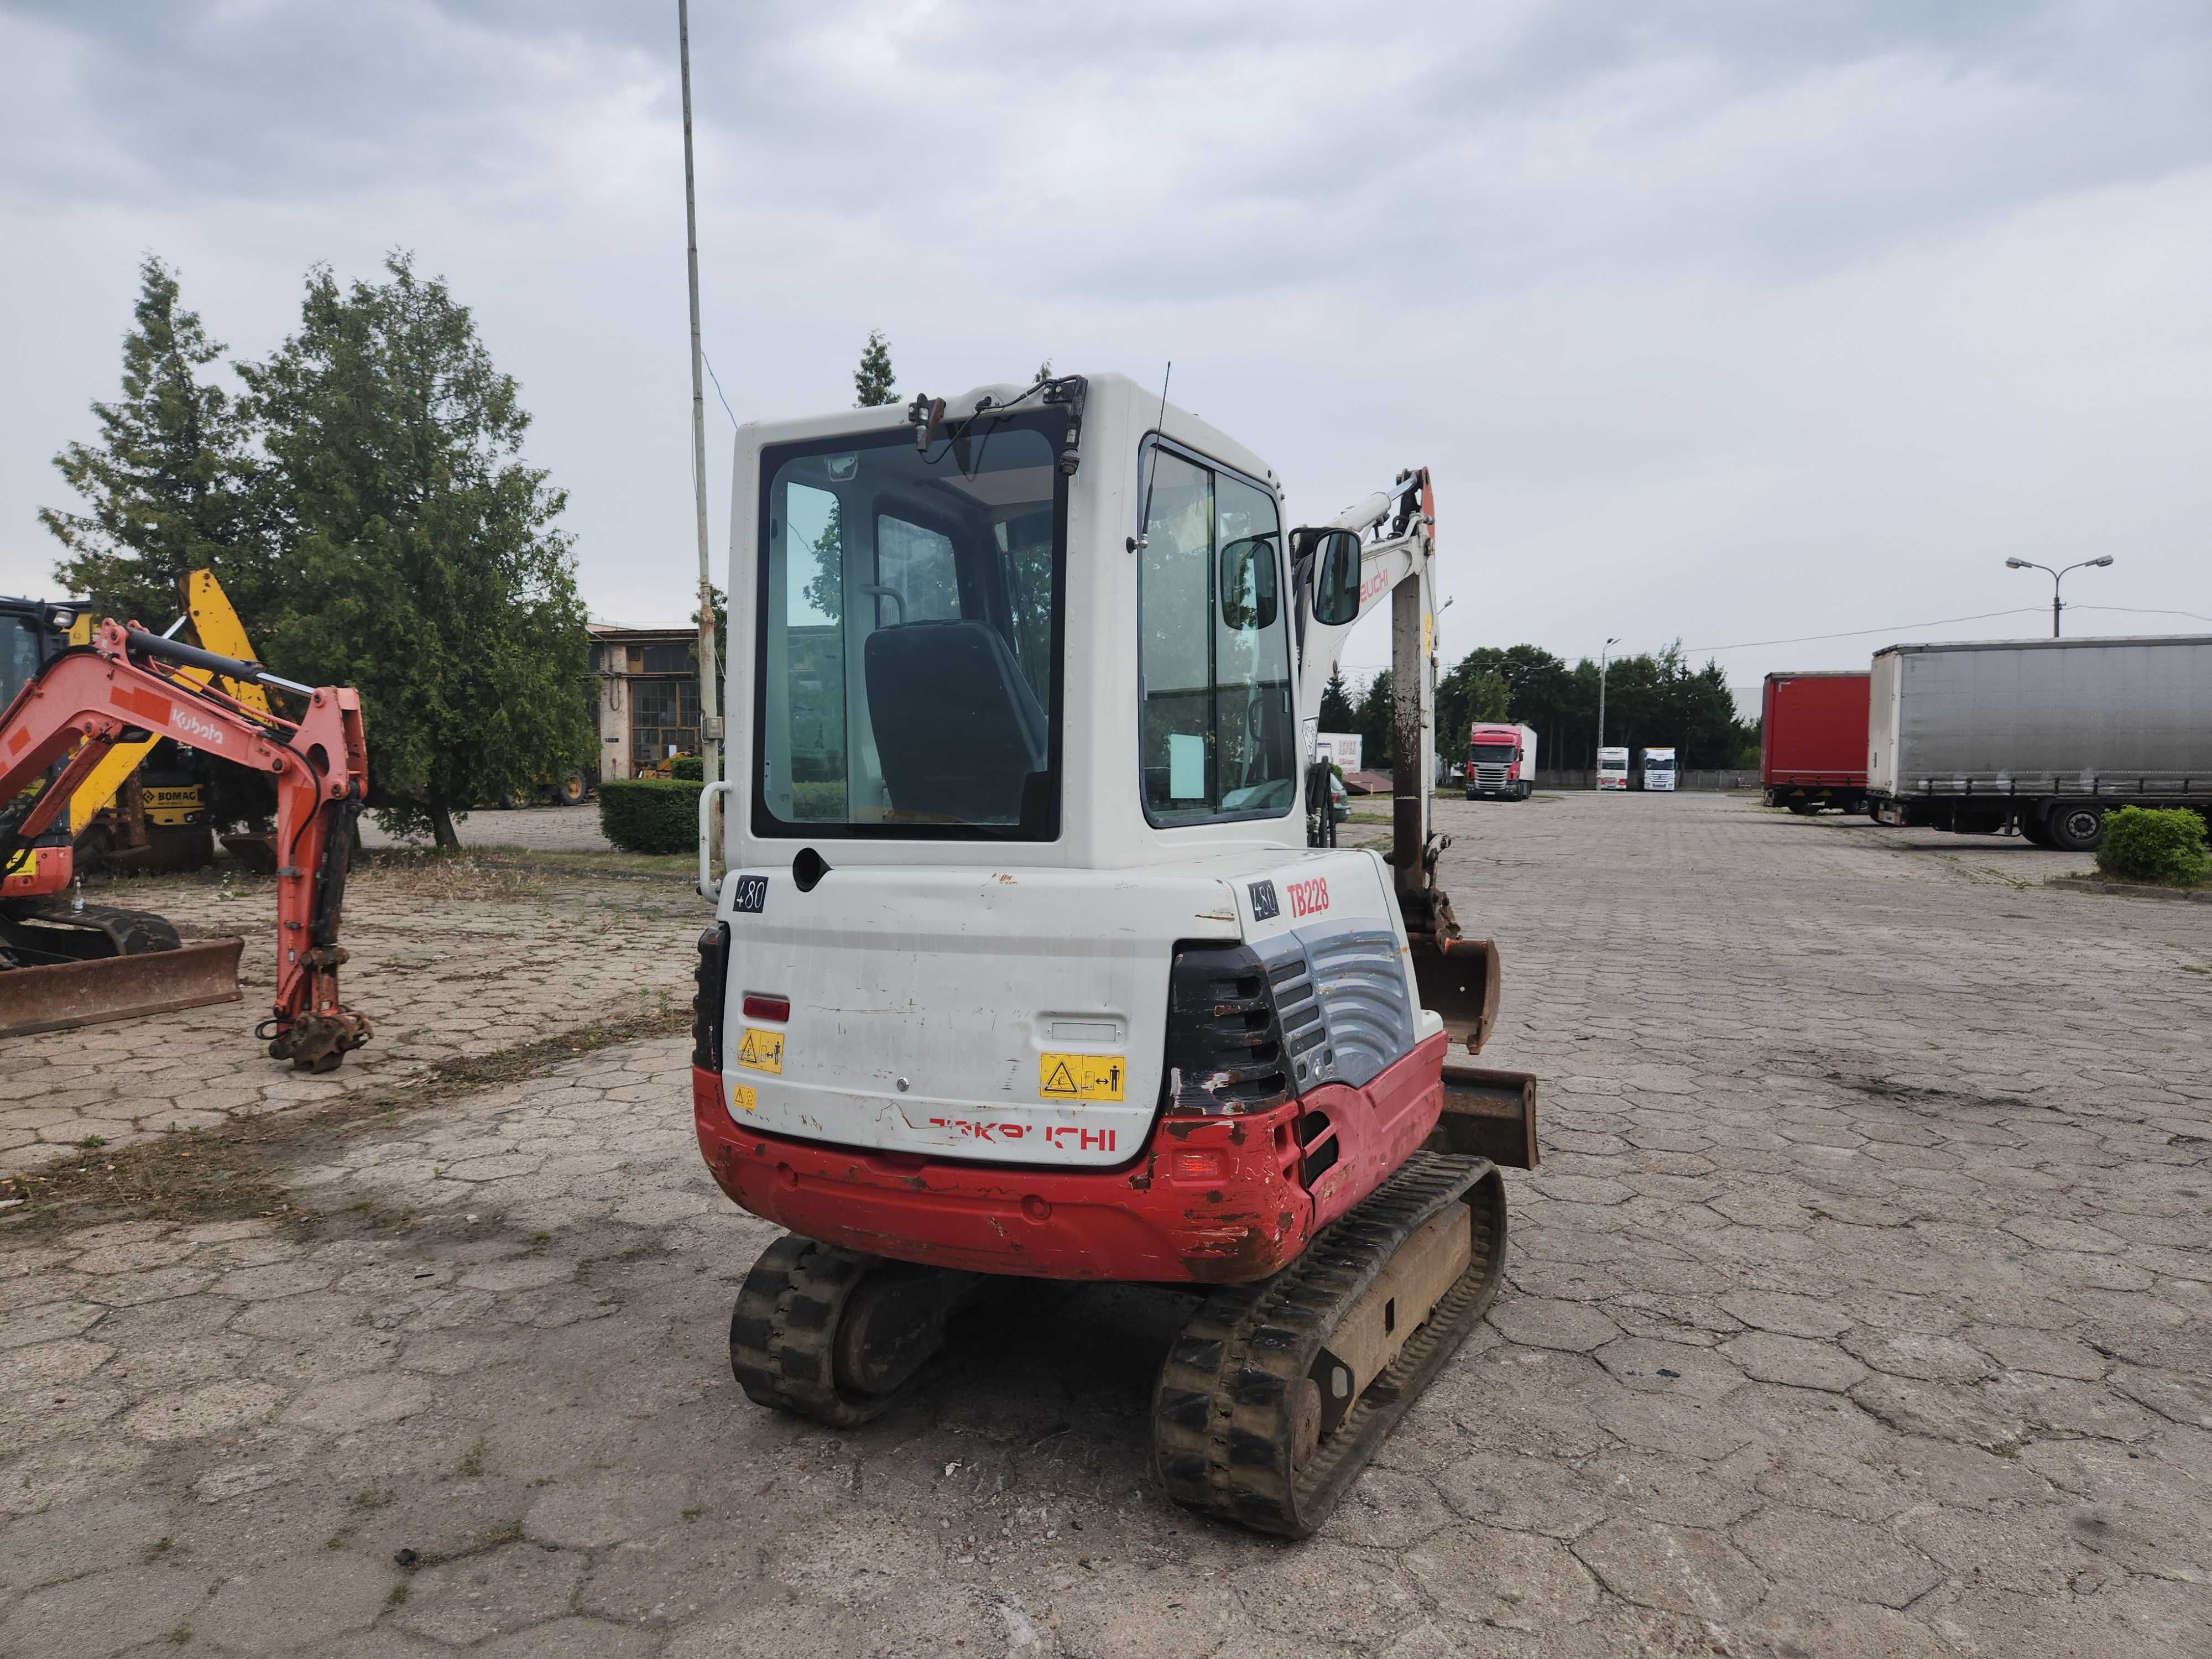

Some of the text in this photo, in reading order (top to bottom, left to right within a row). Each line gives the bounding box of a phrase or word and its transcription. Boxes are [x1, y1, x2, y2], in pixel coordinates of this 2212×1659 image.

[171, 708, 223, 744] Kubota
[158, 791, 196, 801] BOMAG
[737, 880, 765, 909] 480
[1253, 885, 1276, 917] 480
[1287, 877, 1329, 918] TB228
